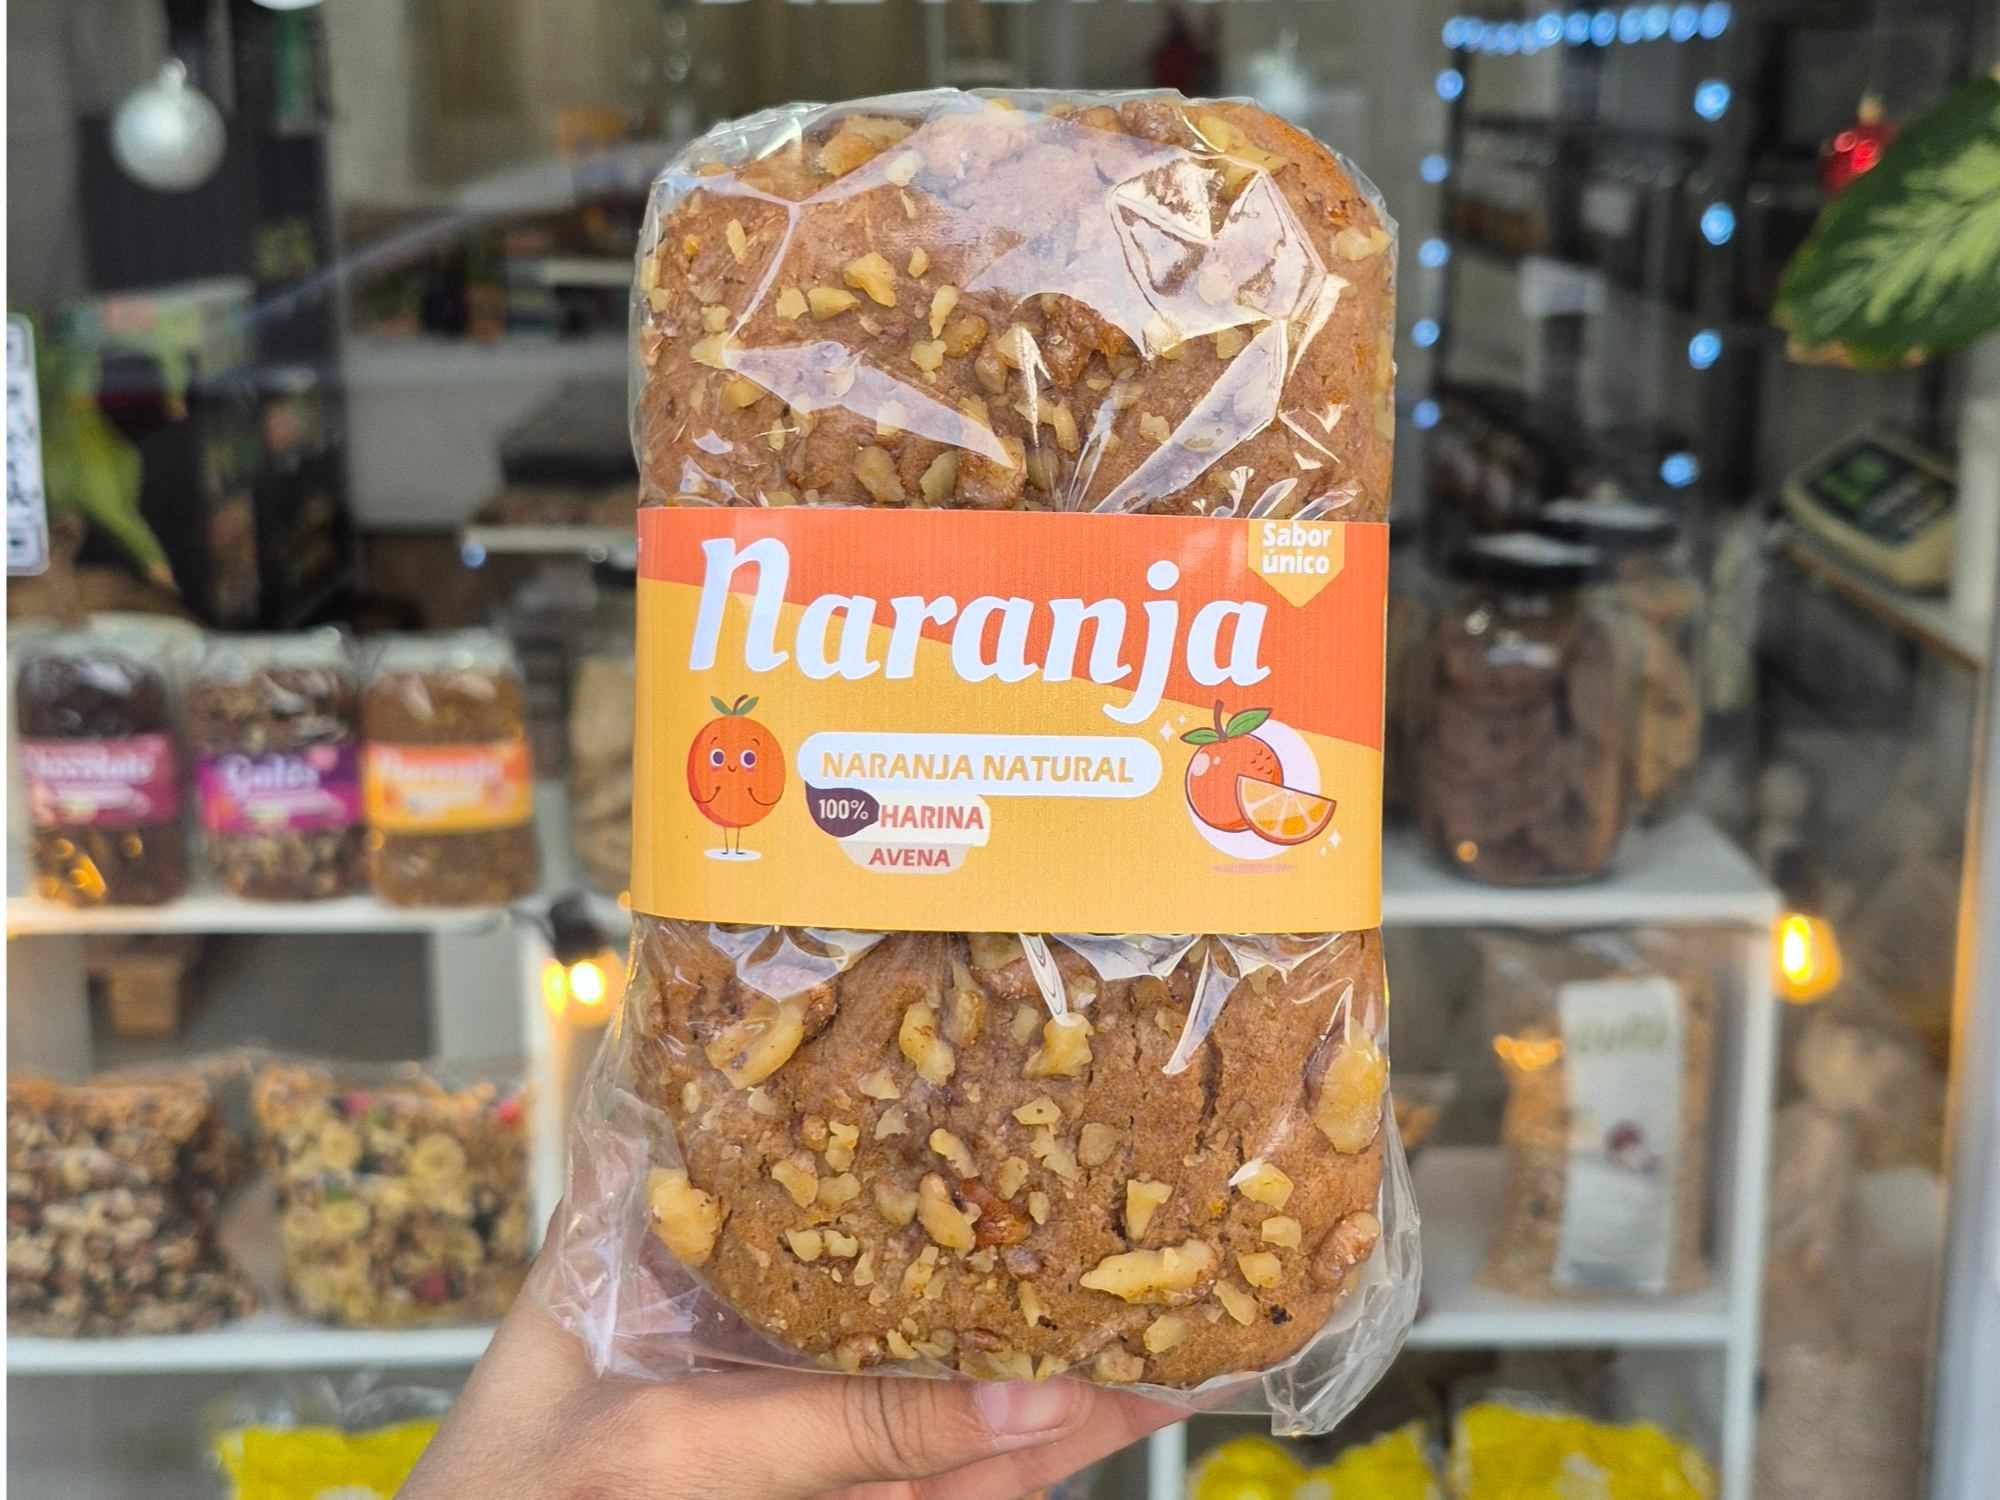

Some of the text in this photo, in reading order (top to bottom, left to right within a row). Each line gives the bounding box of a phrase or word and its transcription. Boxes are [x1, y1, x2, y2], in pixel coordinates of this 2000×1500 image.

[1262, 521, 1332, 548] Sabor
[1262, 548, 1330, 575] único
[689, 537, 1271, 723] Naranja
[821, 751, 1135, 784] NARANJA NATURAL
[818, 798, 985, 830] 100% HARINA
[868, 847, 952, 868] AVENA
